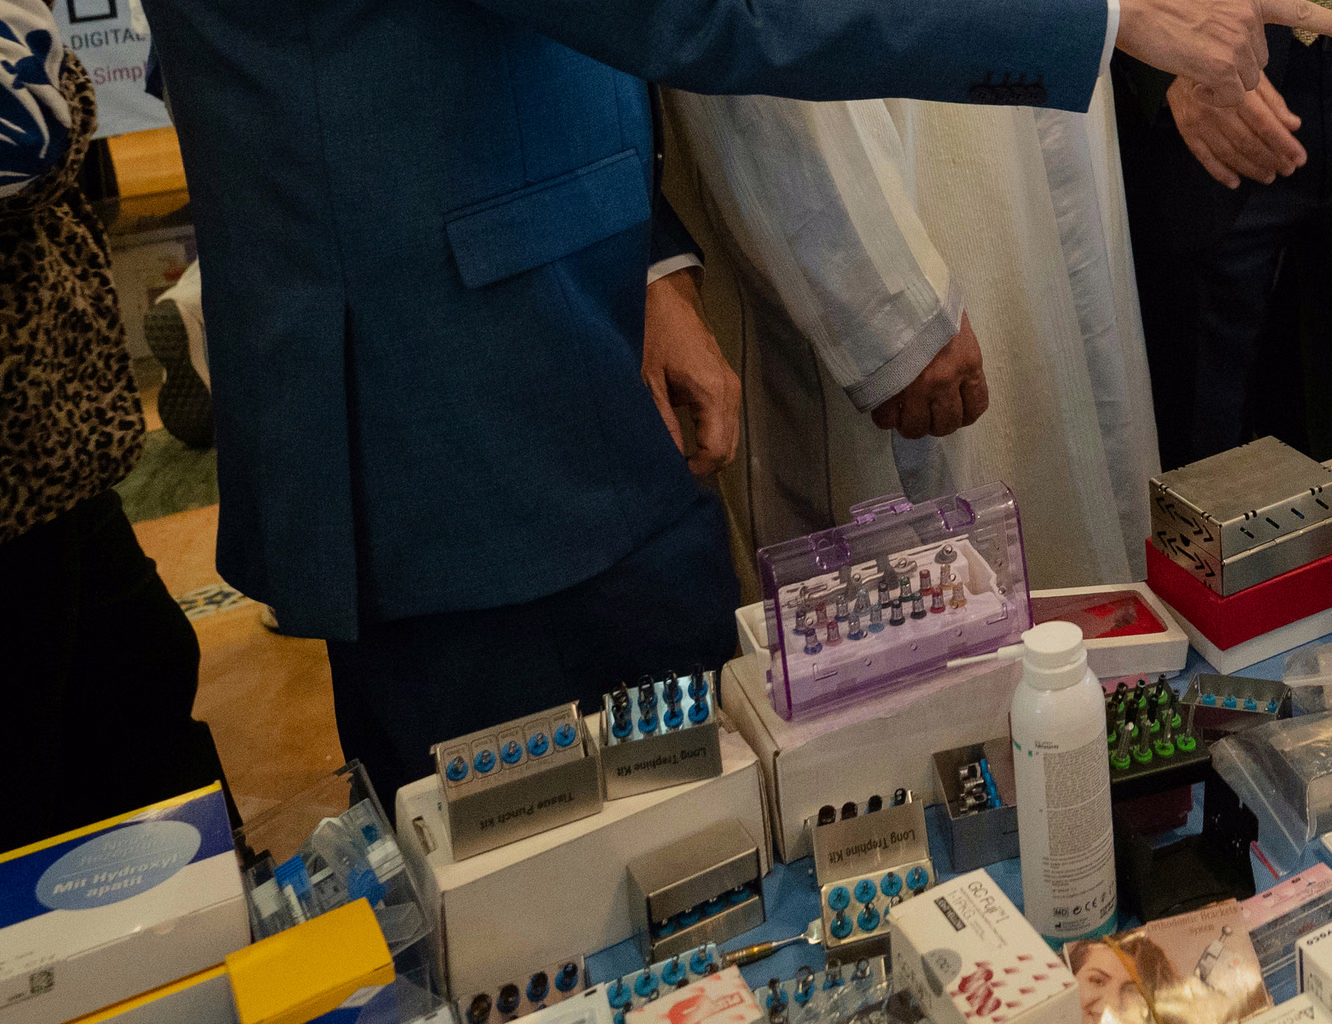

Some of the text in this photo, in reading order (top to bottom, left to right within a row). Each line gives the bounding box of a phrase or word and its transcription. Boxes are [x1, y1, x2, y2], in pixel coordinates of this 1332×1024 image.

[498, 805, 534, 825] Punch
[828, 829, 916, 864] Long Trephine Kit
[53, 878, 86, 895] Mit
[87, 876, 143, 897] apatit
